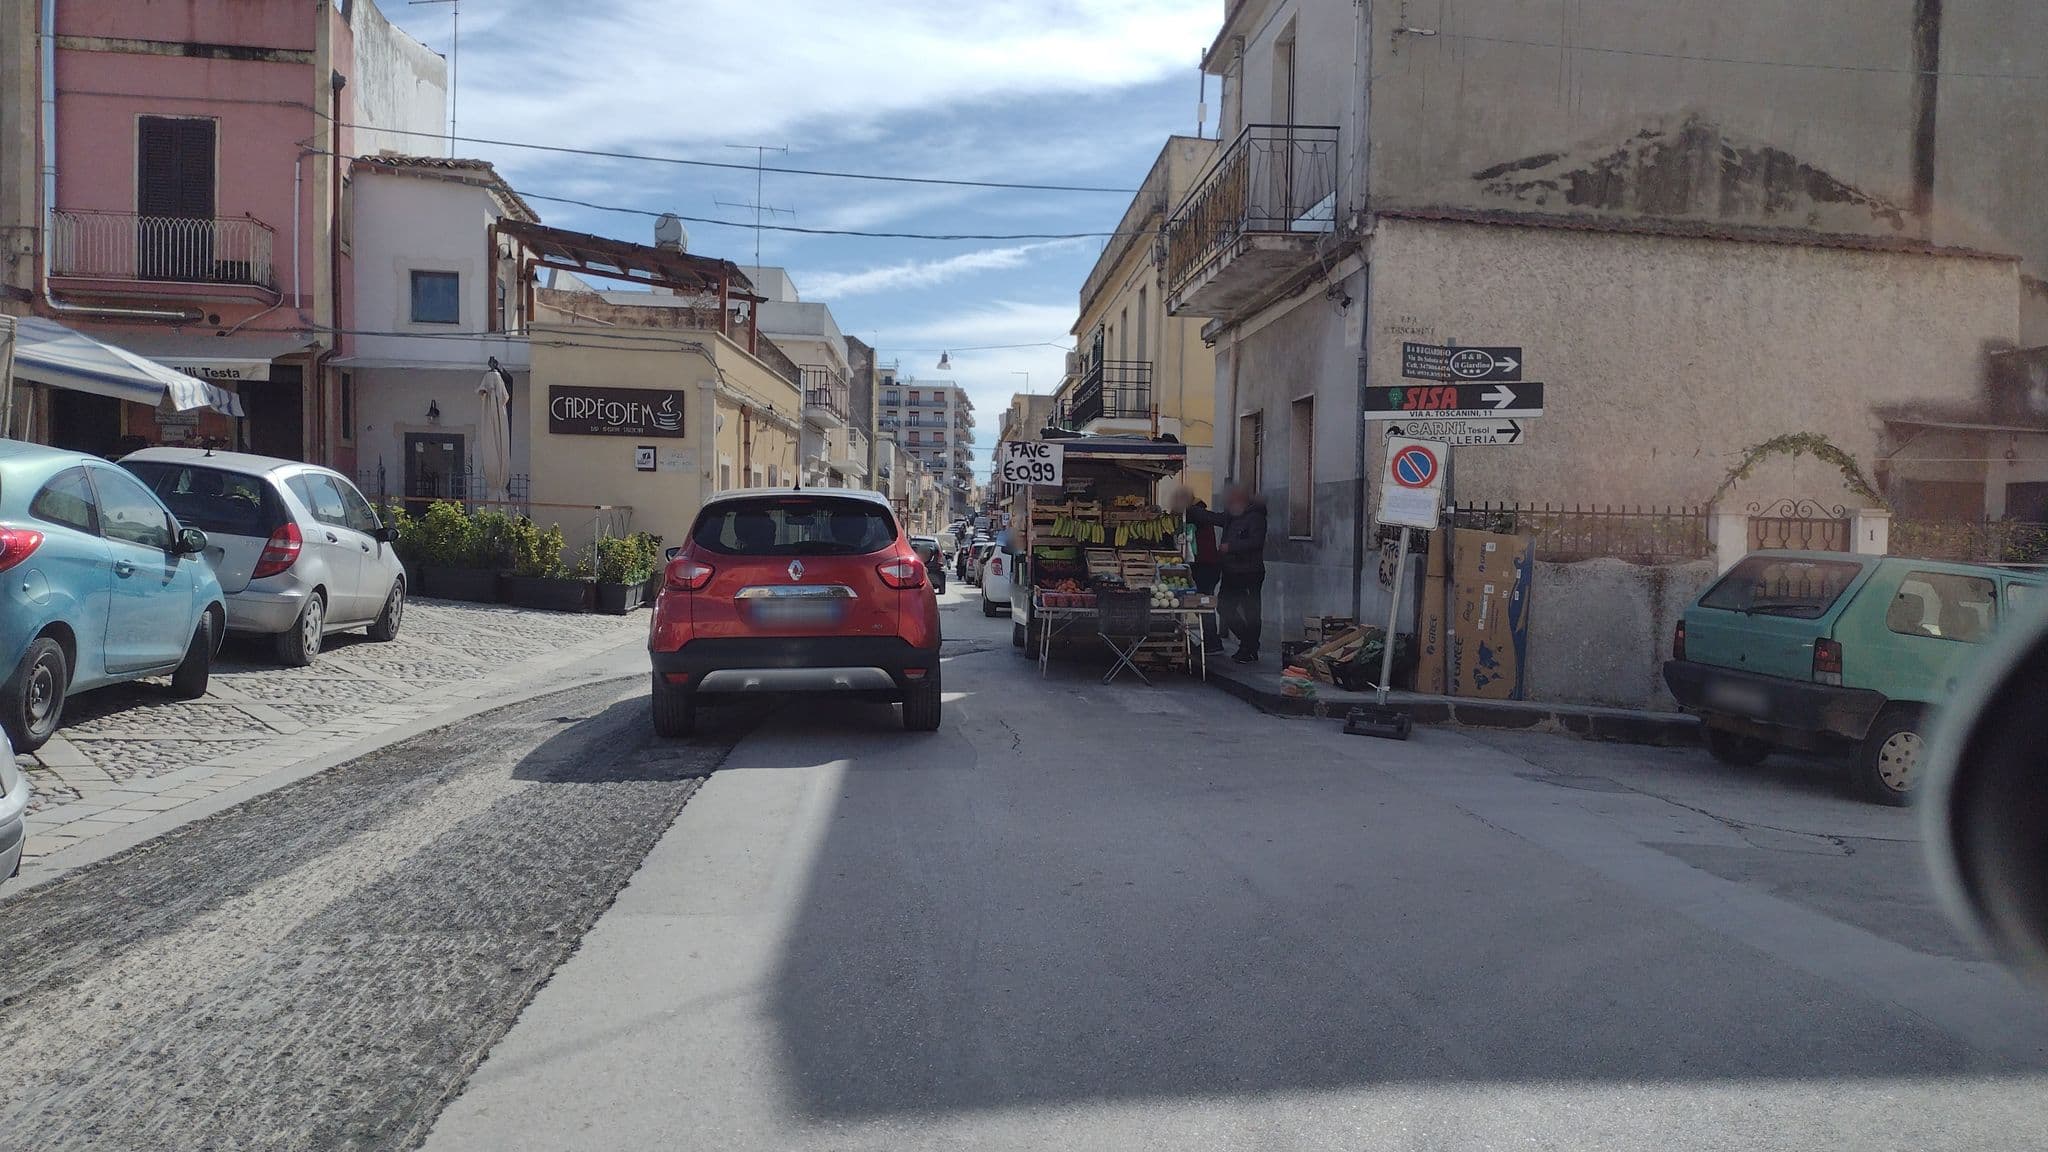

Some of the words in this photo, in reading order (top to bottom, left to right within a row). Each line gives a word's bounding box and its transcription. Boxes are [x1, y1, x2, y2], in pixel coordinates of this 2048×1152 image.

[202, 368, 240, 378] Testa
[1403, 387, 1457, 410] SISA
[1407, 422, 1466, 435] CARNI
[1009, 441, 1050, 458] FAVE
[1004, 461, 1055, 482] €0,99
[1429, 614, 1438, 644] GREE
